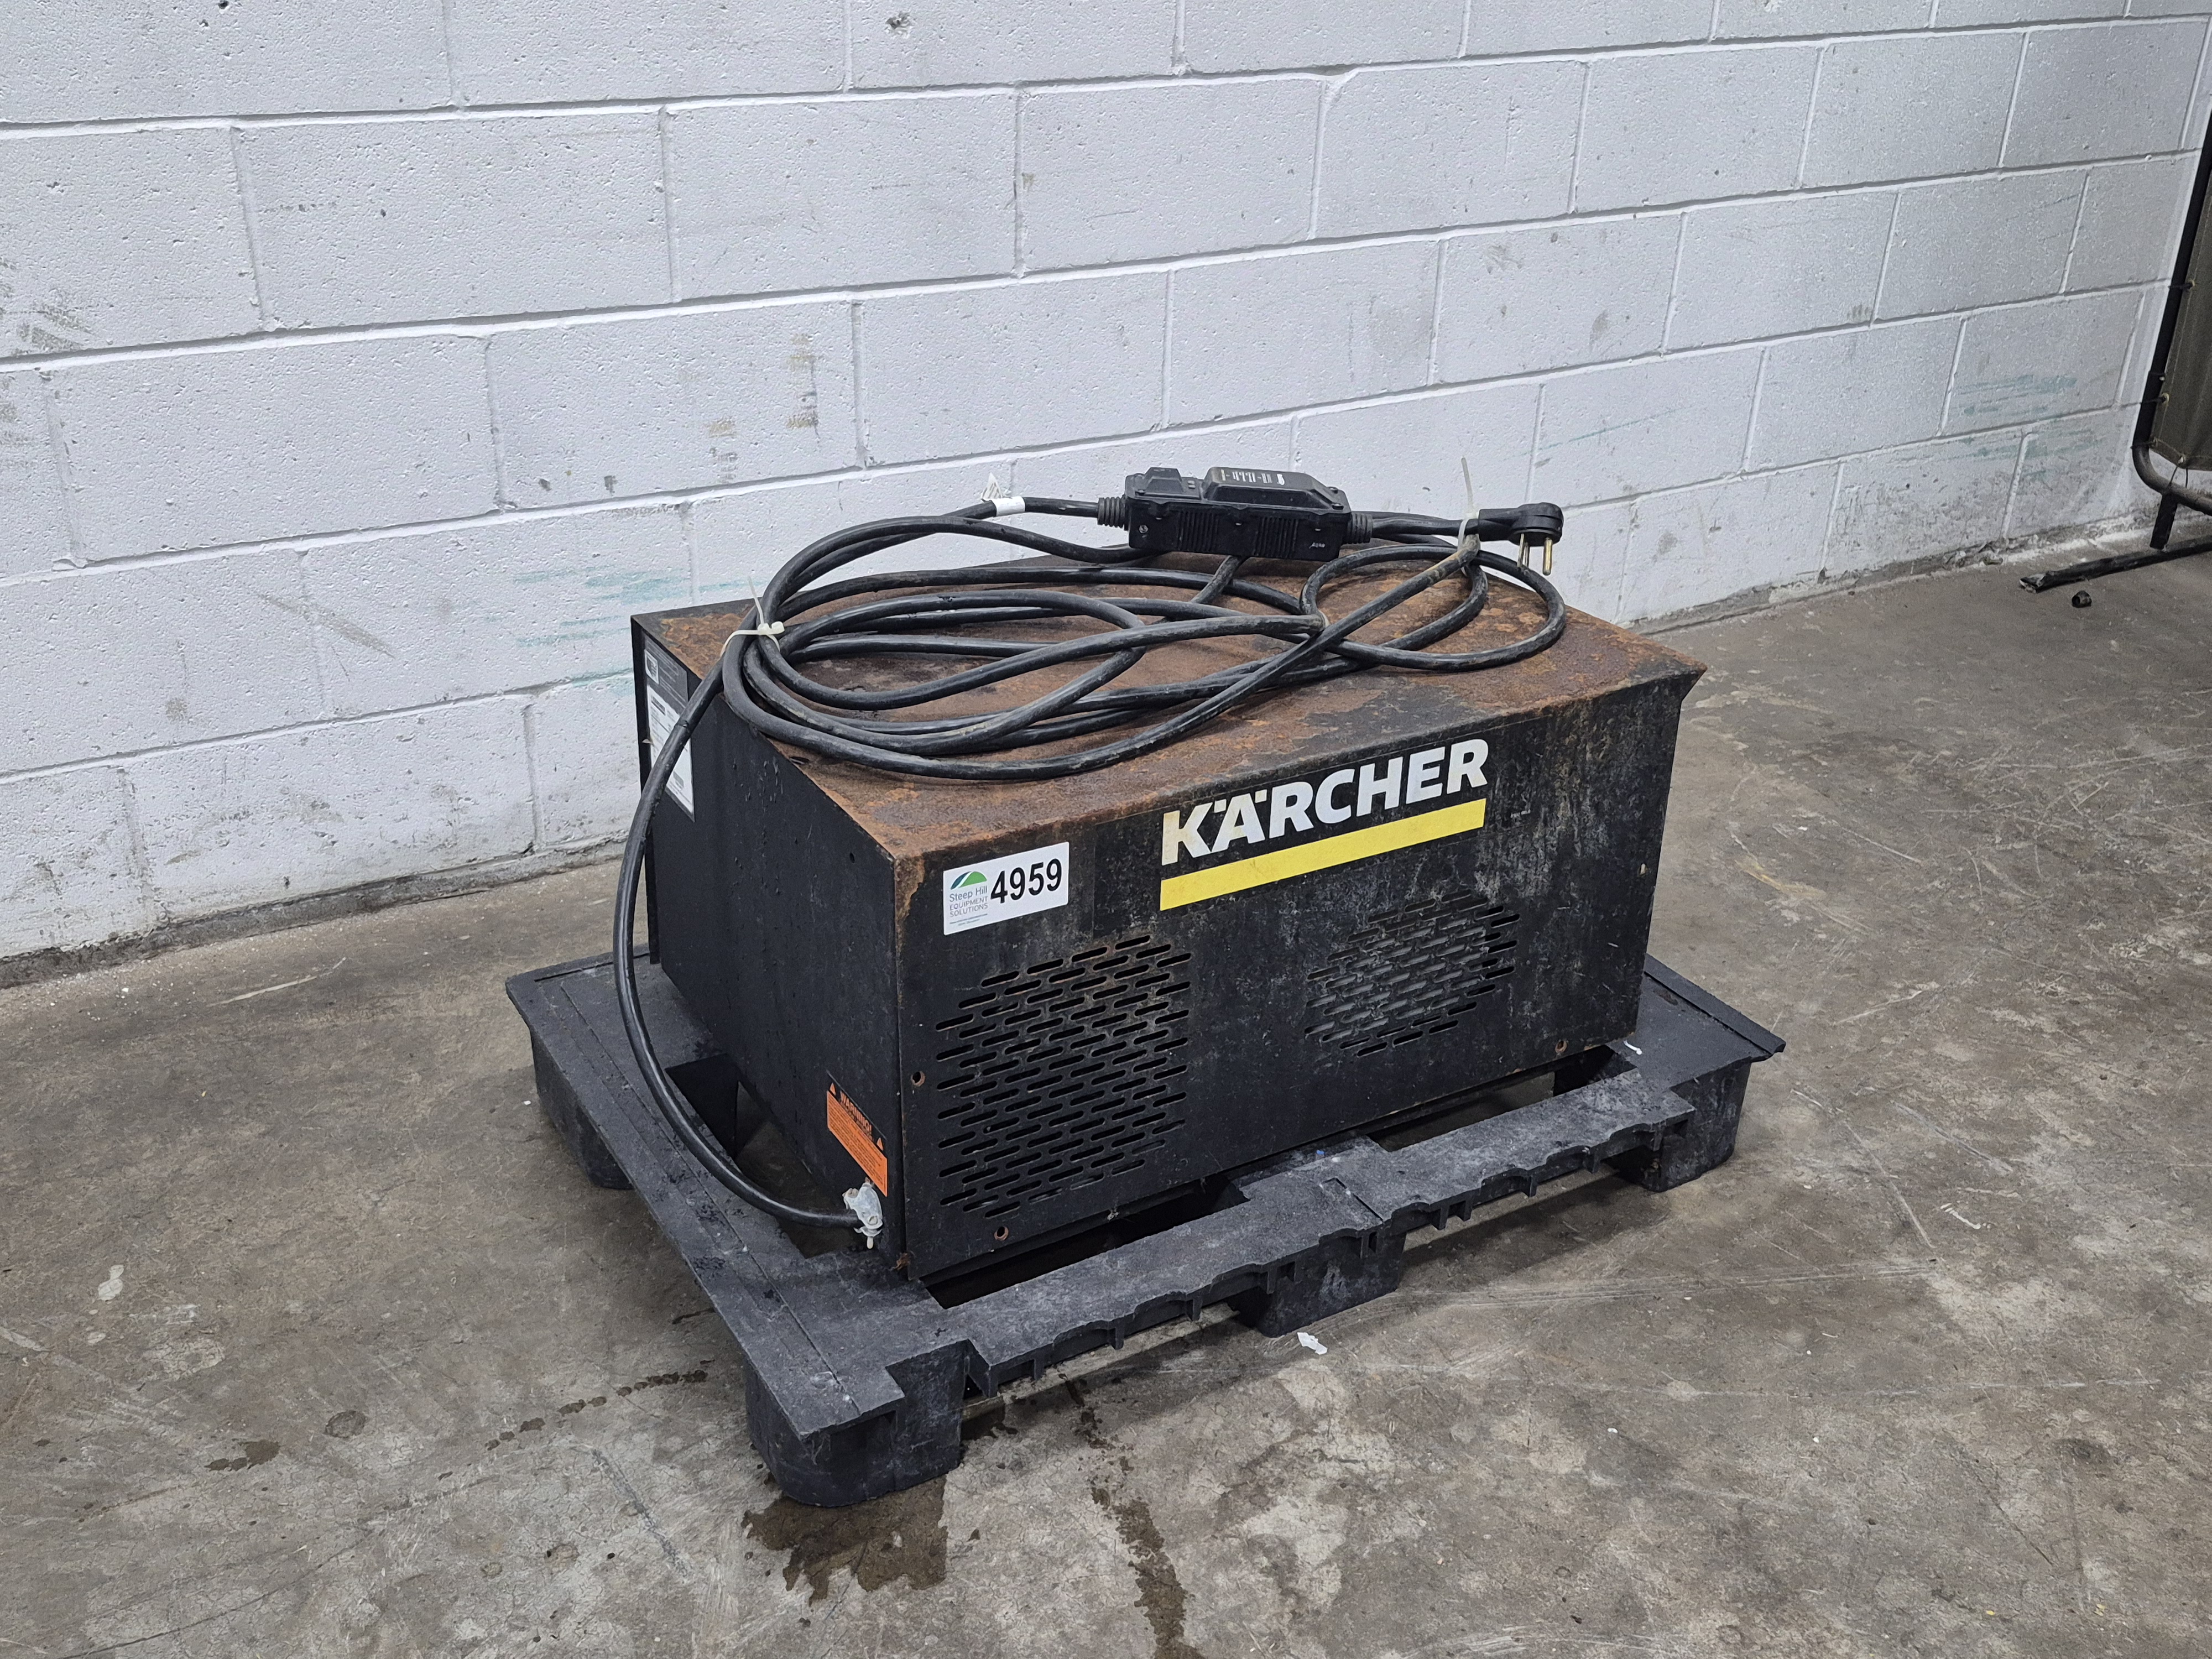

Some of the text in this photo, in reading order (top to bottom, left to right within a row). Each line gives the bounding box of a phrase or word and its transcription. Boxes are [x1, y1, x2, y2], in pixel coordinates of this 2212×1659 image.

[1161, 739, 1489, 866] KÄRCHER
[990, 858, 1062, 904] 4959
[950, 885, 987, 902] Steep Hill
[949, 895, 988, 911] EQUIPMENT
[950, 903, 988, 917] SOLUTIONS
